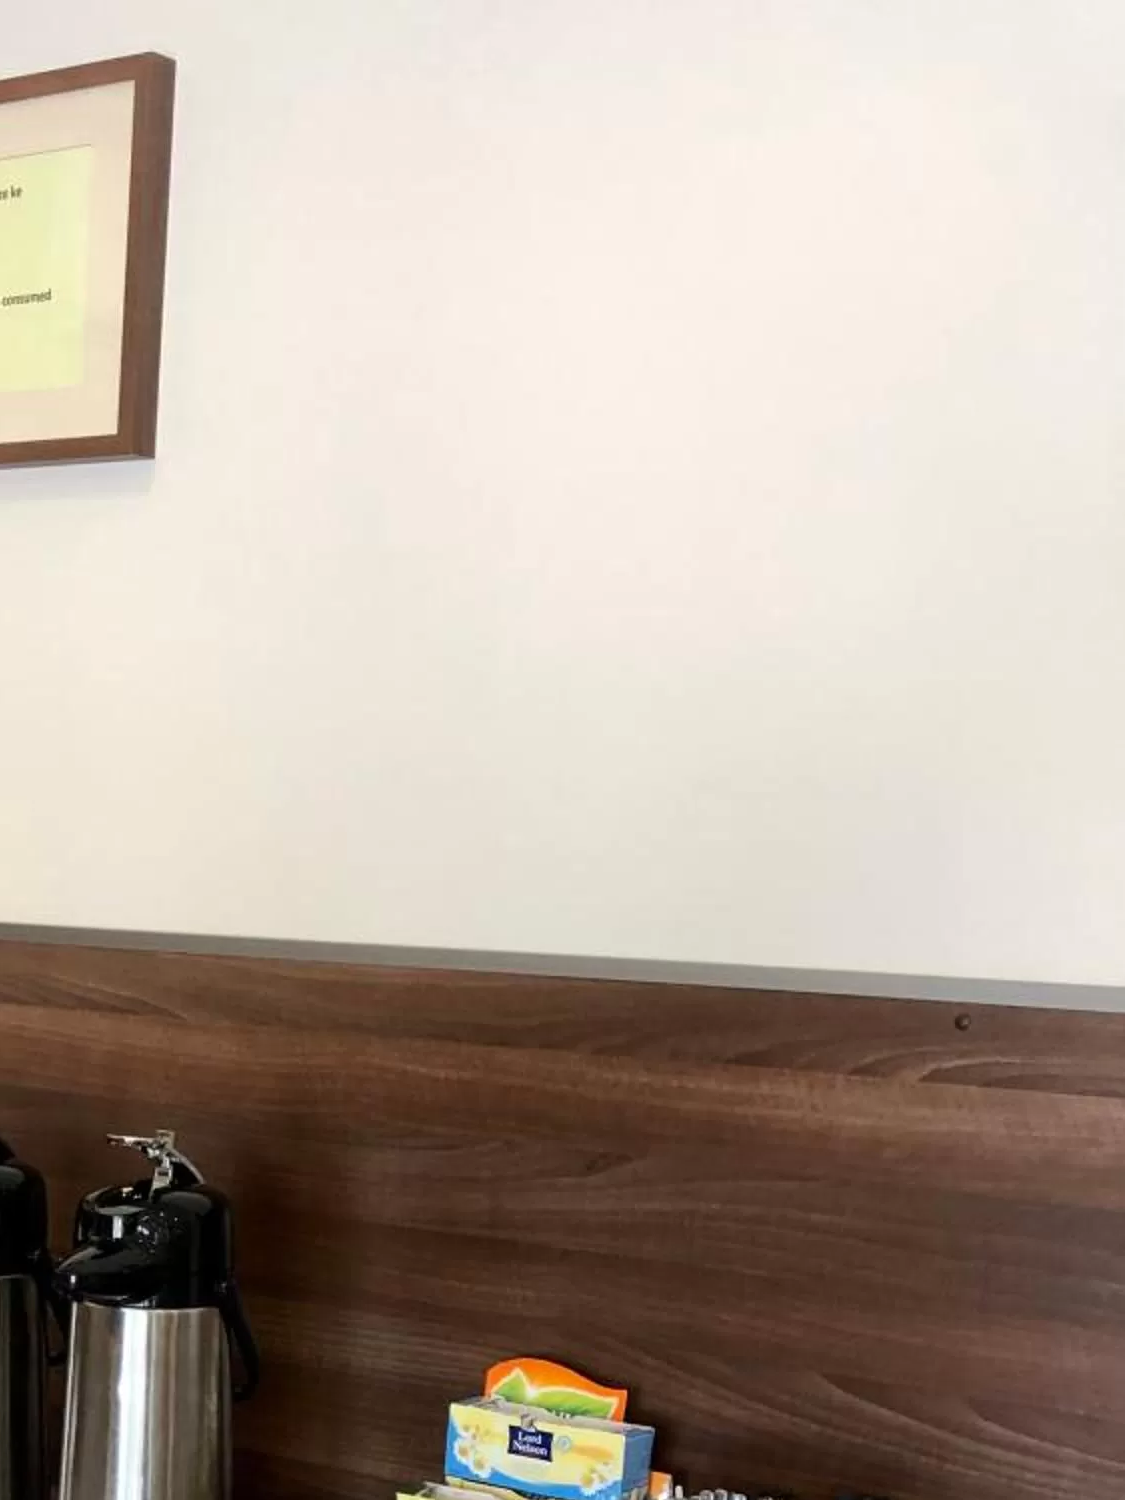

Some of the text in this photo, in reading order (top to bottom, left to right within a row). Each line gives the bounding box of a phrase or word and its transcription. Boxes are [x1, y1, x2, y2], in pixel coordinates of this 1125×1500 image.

[10, 185, 23, 198] ke
[2, 288, 52, 306] consumed
[517, 1431, 542, 1445] Lord
[512, 1439, 549, 1457] Nelson
